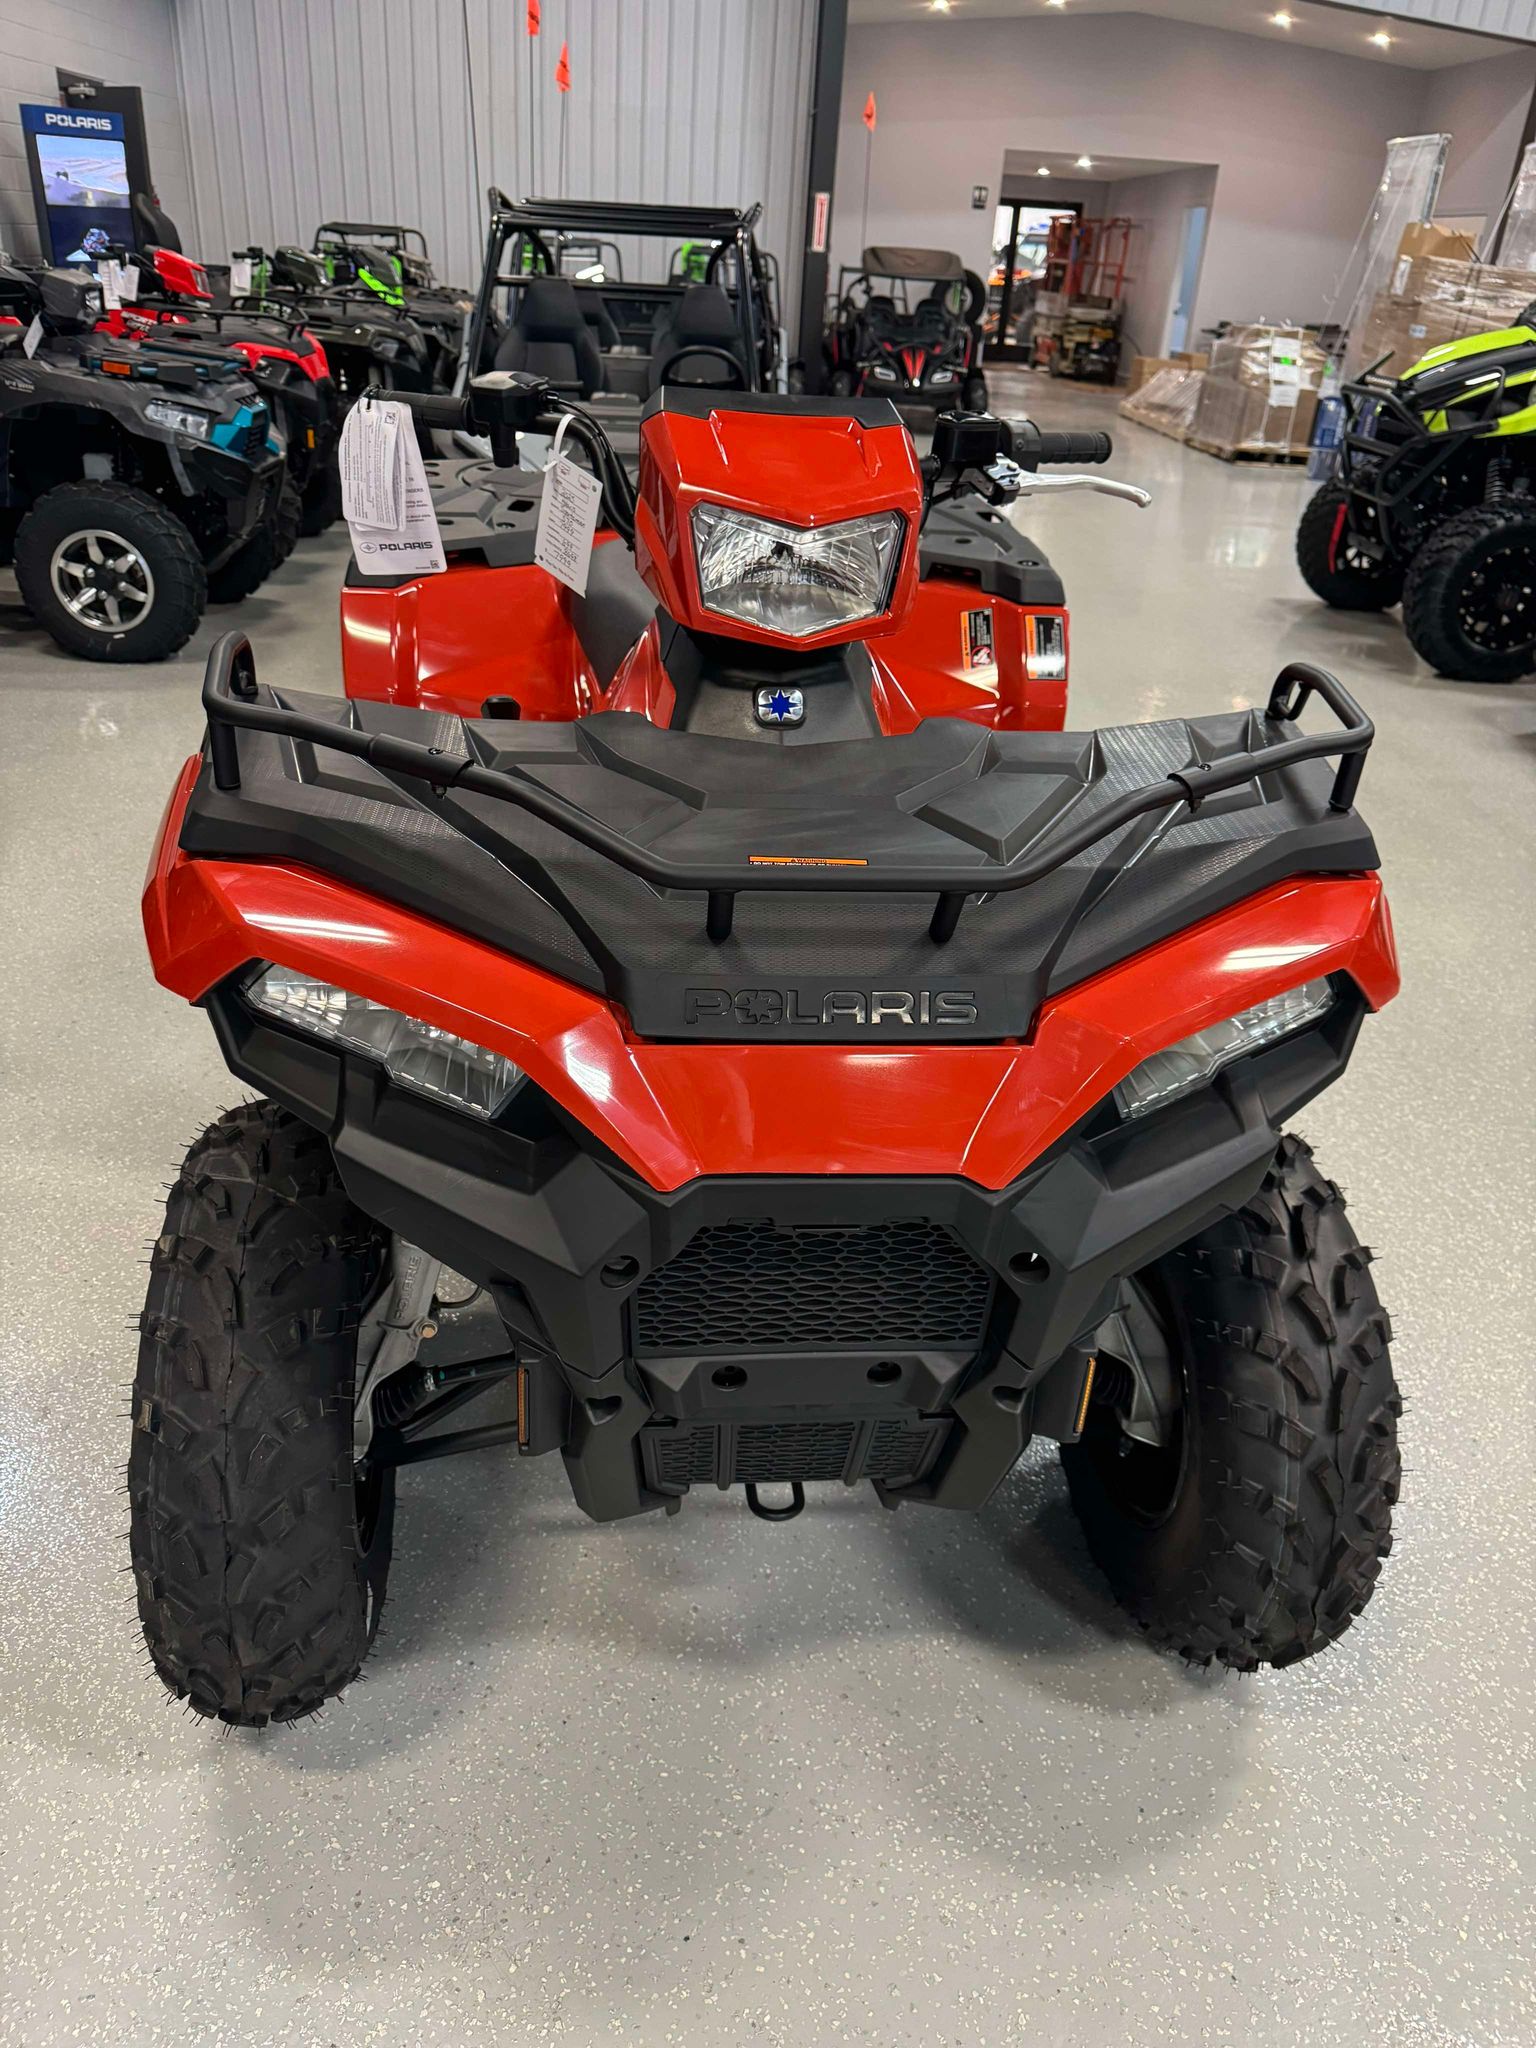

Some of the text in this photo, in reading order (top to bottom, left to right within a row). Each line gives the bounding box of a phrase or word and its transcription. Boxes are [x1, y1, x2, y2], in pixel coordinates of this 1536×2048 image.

[45, 113, 113, 131] POLARIS
[379, 541, 433, 552] POLARIS
[685, 988, 978, 1025] POLARIS
[396, 1256, 422, 1320] POLARIS
